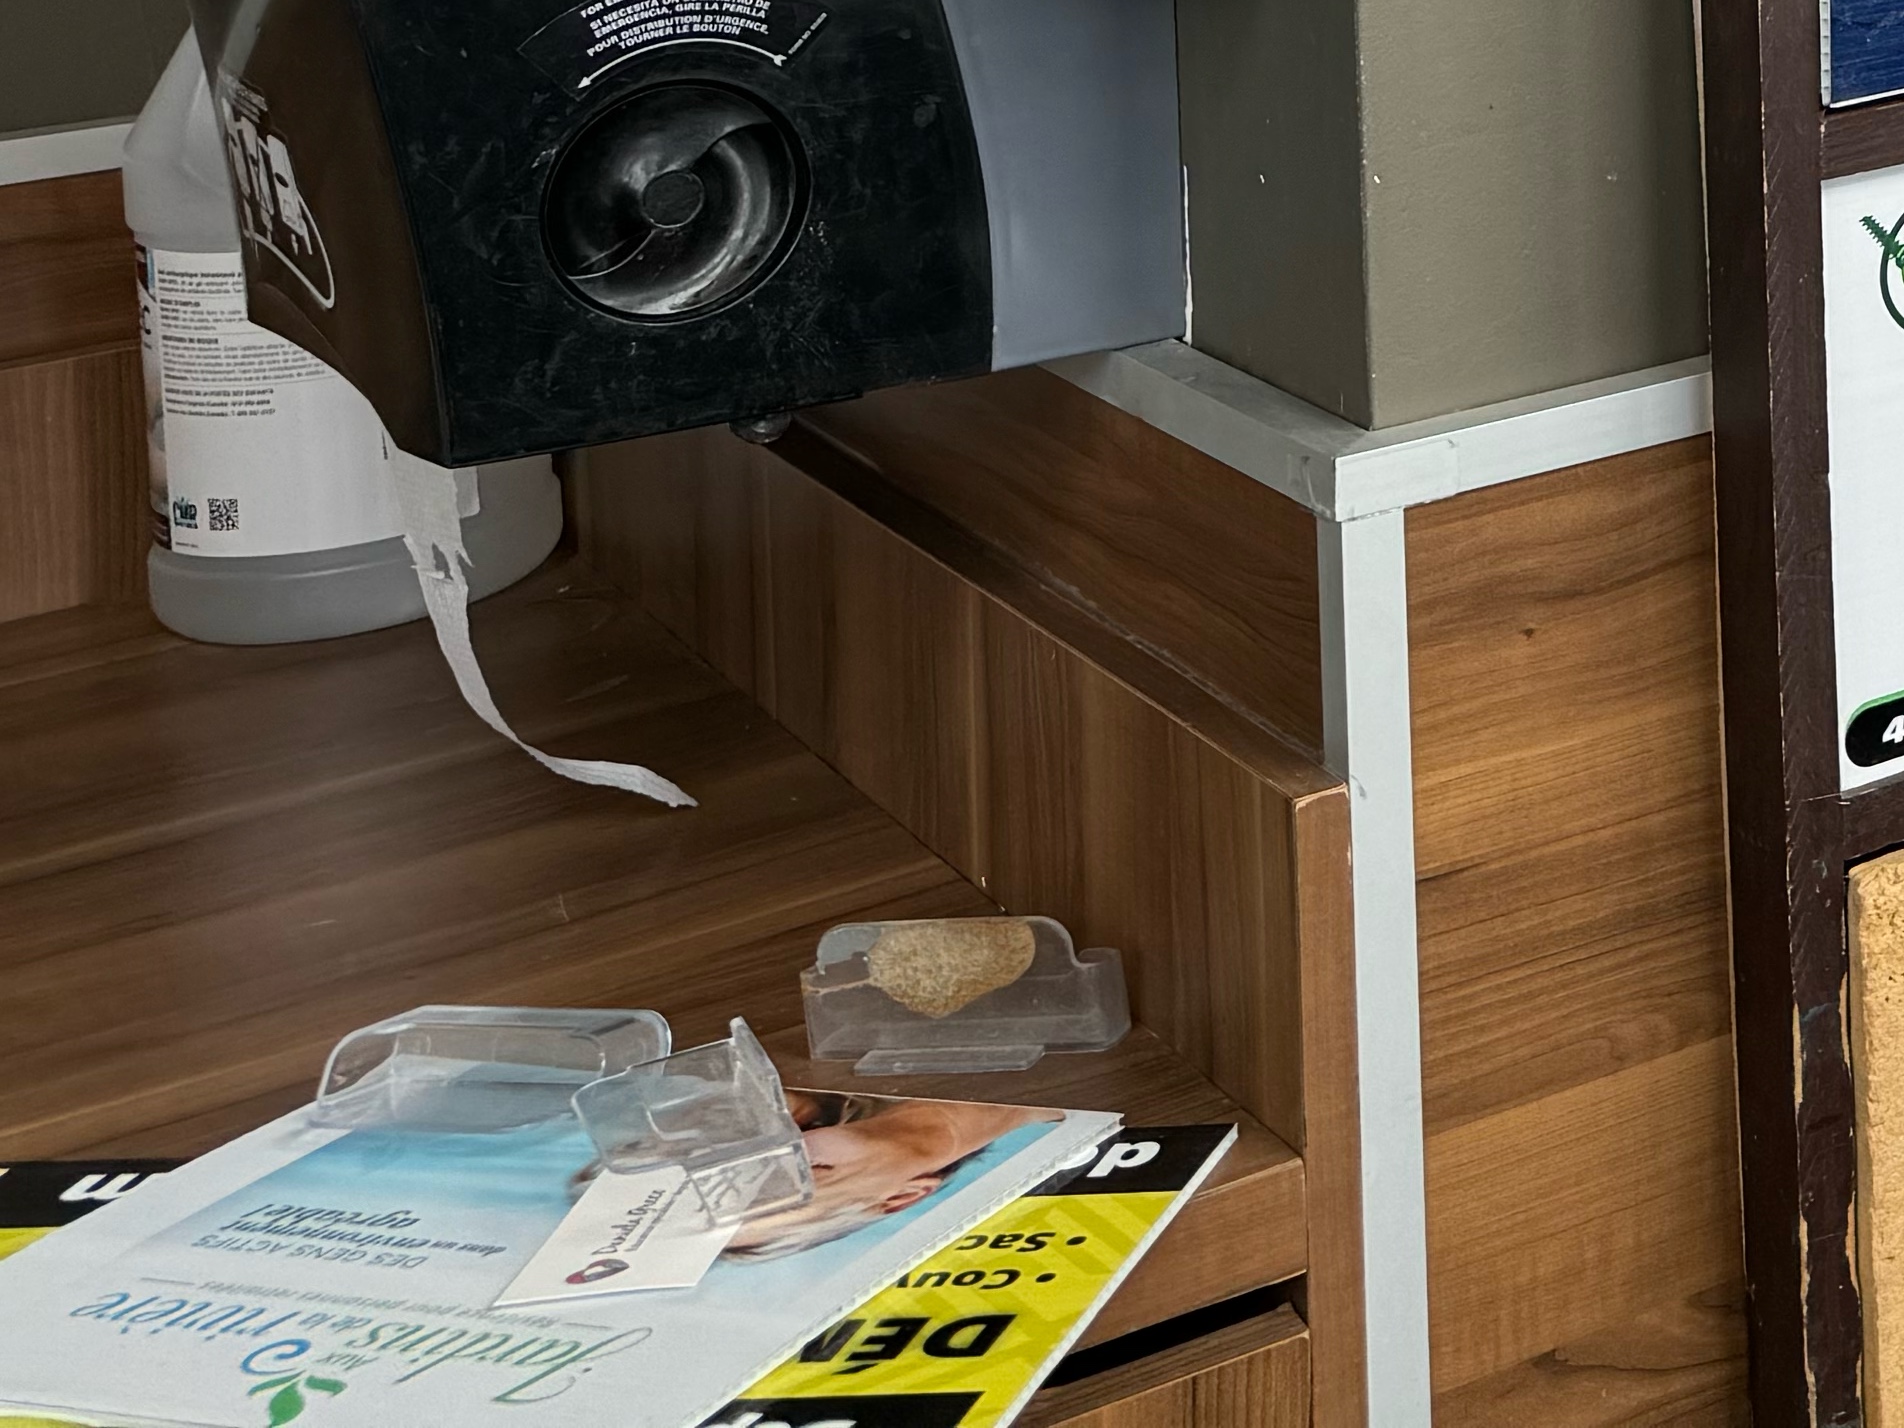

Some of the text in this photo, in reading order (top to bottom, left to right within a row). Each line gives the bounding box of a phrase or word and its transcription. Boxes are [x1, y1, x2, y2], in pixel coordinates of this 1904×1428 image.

[580, 3, 604, 18] FOR
[590, 20, 602, 30] SI
[604, 0, 659, 24] NECESITA
[755, 0, 770, 10] DE
[594, 1, 766, 38] EMERGENCIA, GIRE LA PERILLA
[587, 15, 701, 57] POUR DISTRIBUTION
[618, 23, 740, 49] TOURNER LE BOUTON
[187, 1233, 427, 1270] DES GENS ACTIFS
[68, 1290, 652, 1405] Jardins rivière
